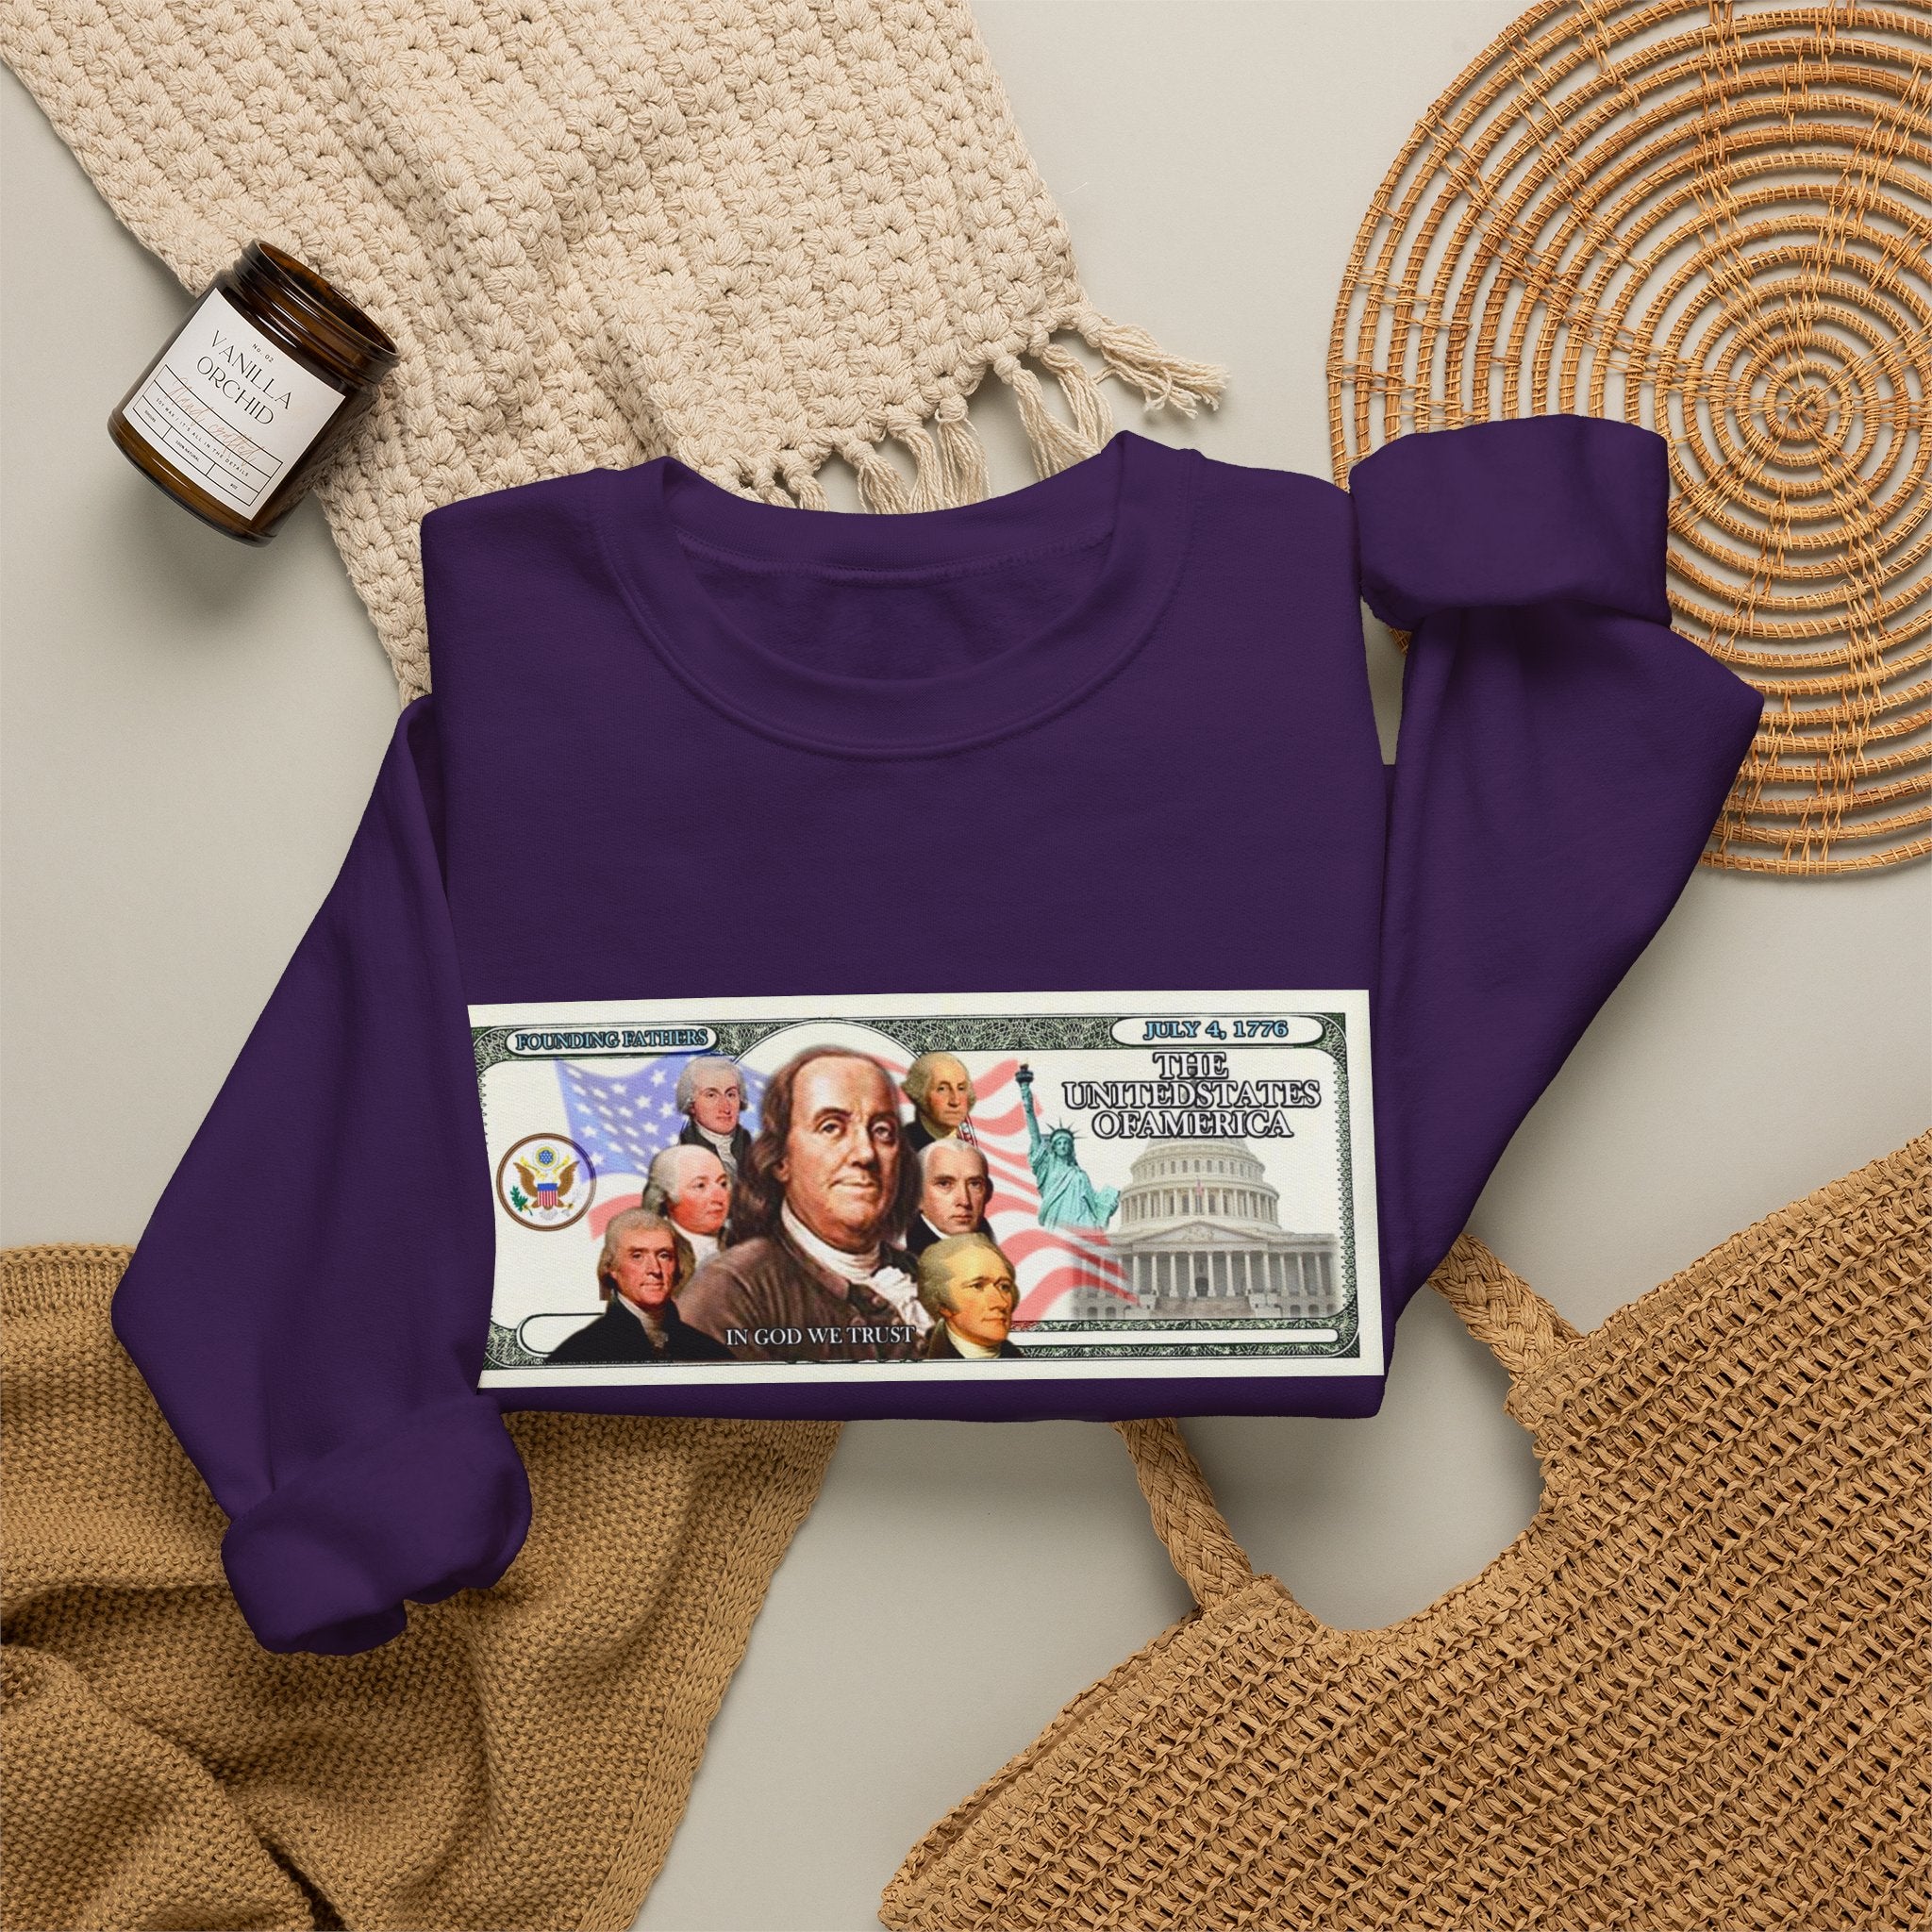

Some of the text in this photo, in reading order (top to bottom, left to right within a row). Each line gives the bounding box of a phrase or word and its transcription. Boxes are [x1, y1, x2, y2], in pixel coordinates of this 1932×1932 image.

[252, 343, 275, 363] No. 02
[211, 329, 291, 409] VANILLA
[197, 356, 274, 425] ORCHID
[192, 432, 202, 441] ALL
[212, 448, 224, 458] THE
[225, 458, 249, 477] DETAILS
[515, 1029, 708, 1050] FOUNDING FATHERS
[1143, 1020, 1289, 1041] JULY 4, 1776
[1153, 1052, 1228, 1080] THE
[725, 1325, 915, 1346] IN GOD WE TRUST
